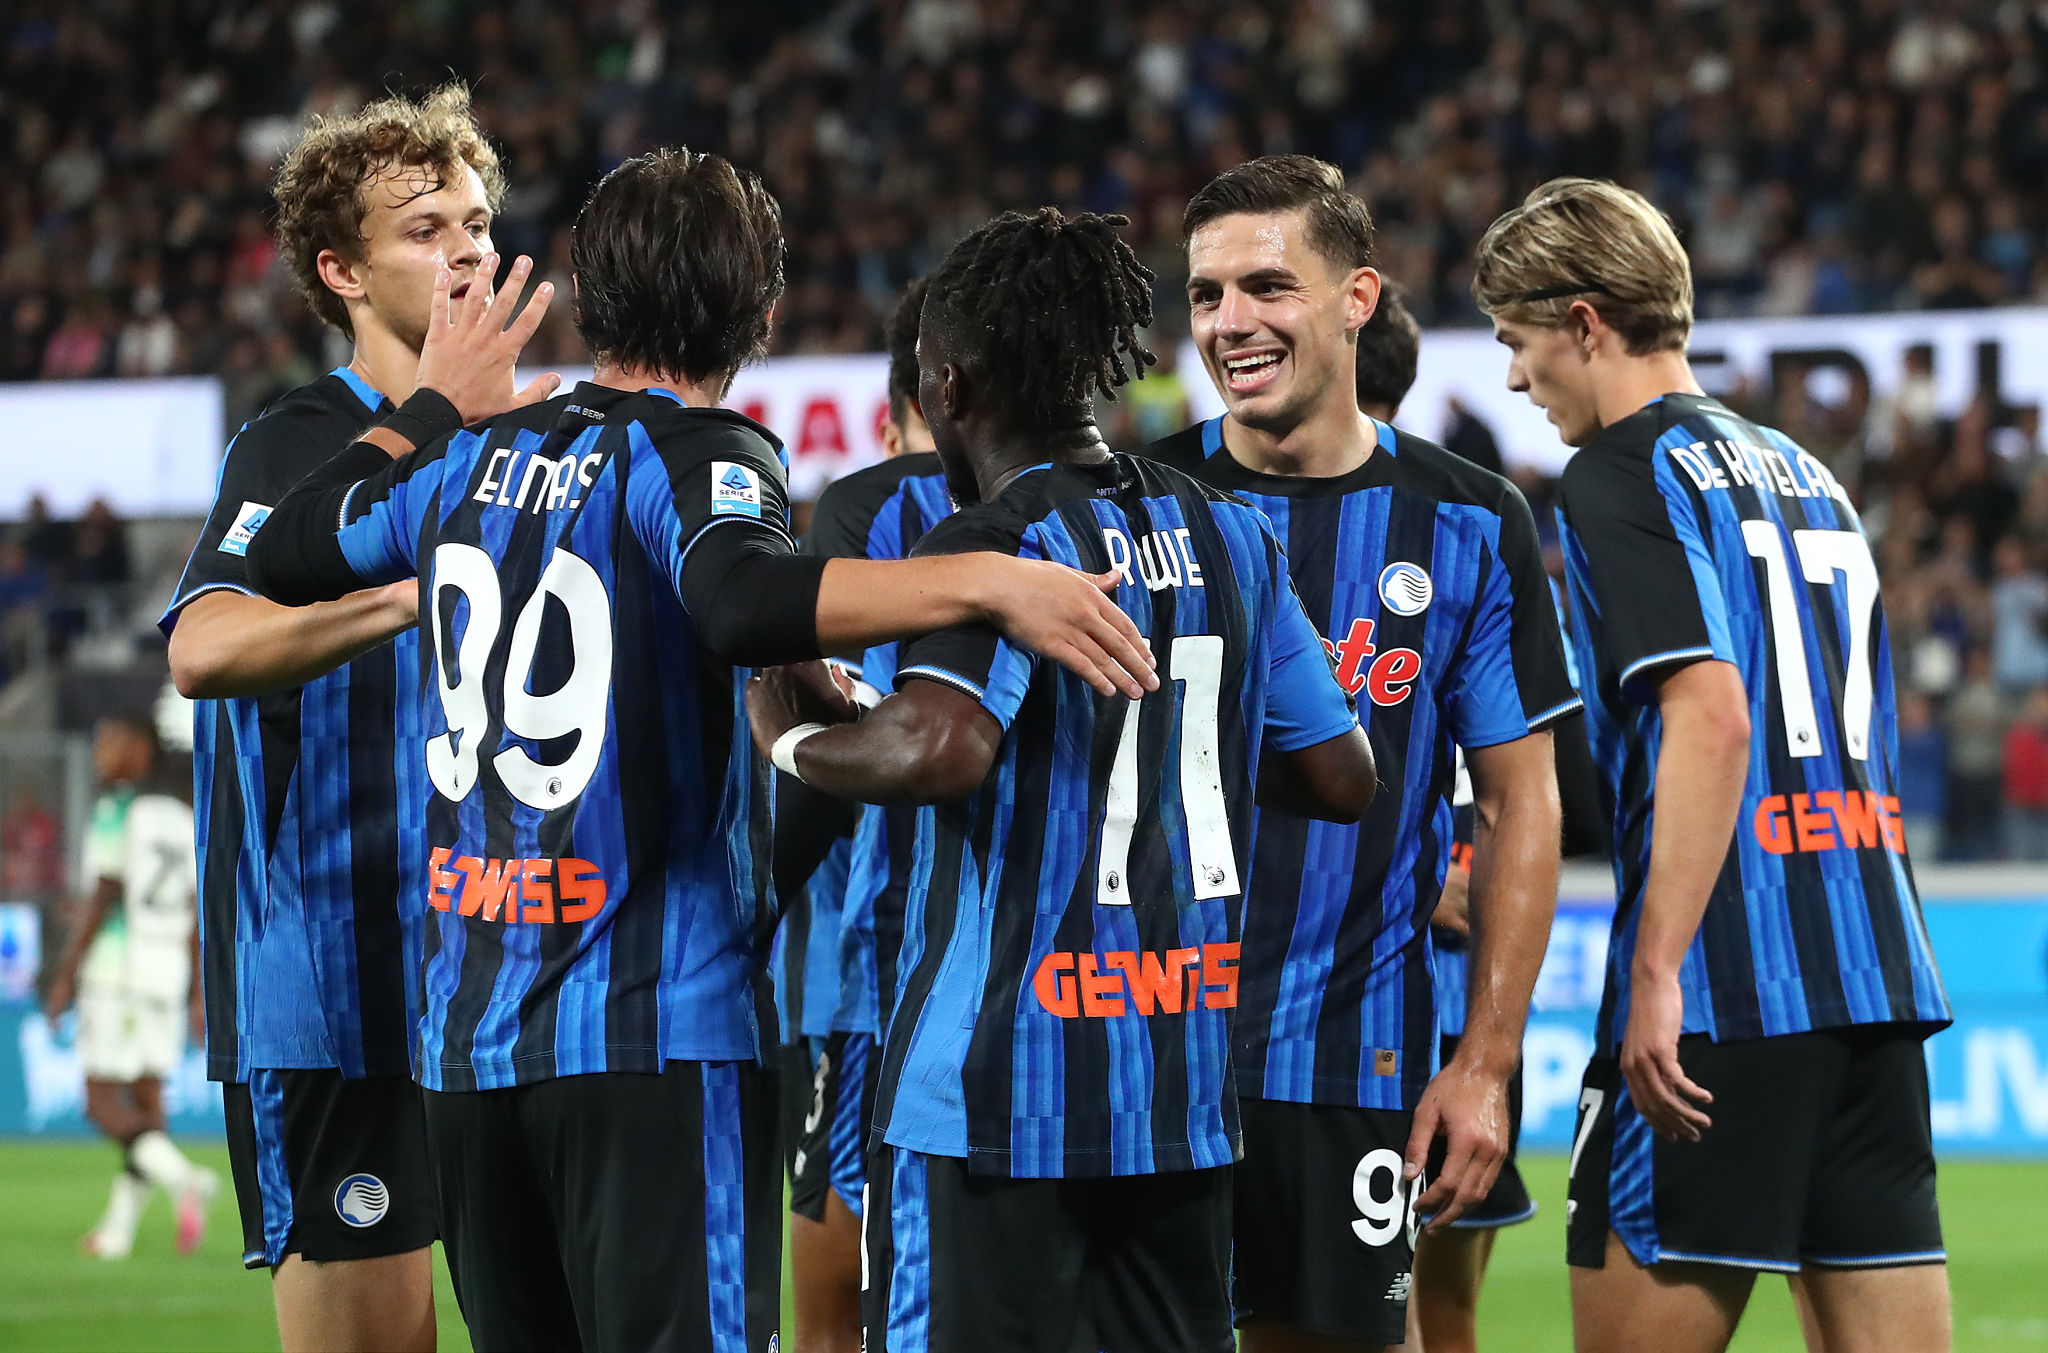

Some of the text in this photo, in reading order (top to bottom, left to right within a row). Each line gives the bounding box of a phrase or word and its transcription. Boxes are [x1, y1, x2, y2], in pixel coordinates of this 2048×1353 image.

[472, 447, 603, 515] ELMAS
[719, 489, 745, 497] SERIE
[1669, 439, 1856, 501] DE KETELA
[234, 531, 254, 541] SERI
[426, 542, 613, 811] 99
[1320, 617, 1422, 707] te
[1740, 519, 1880, 762] 17
[1097, 634, 1242, 906] 11
